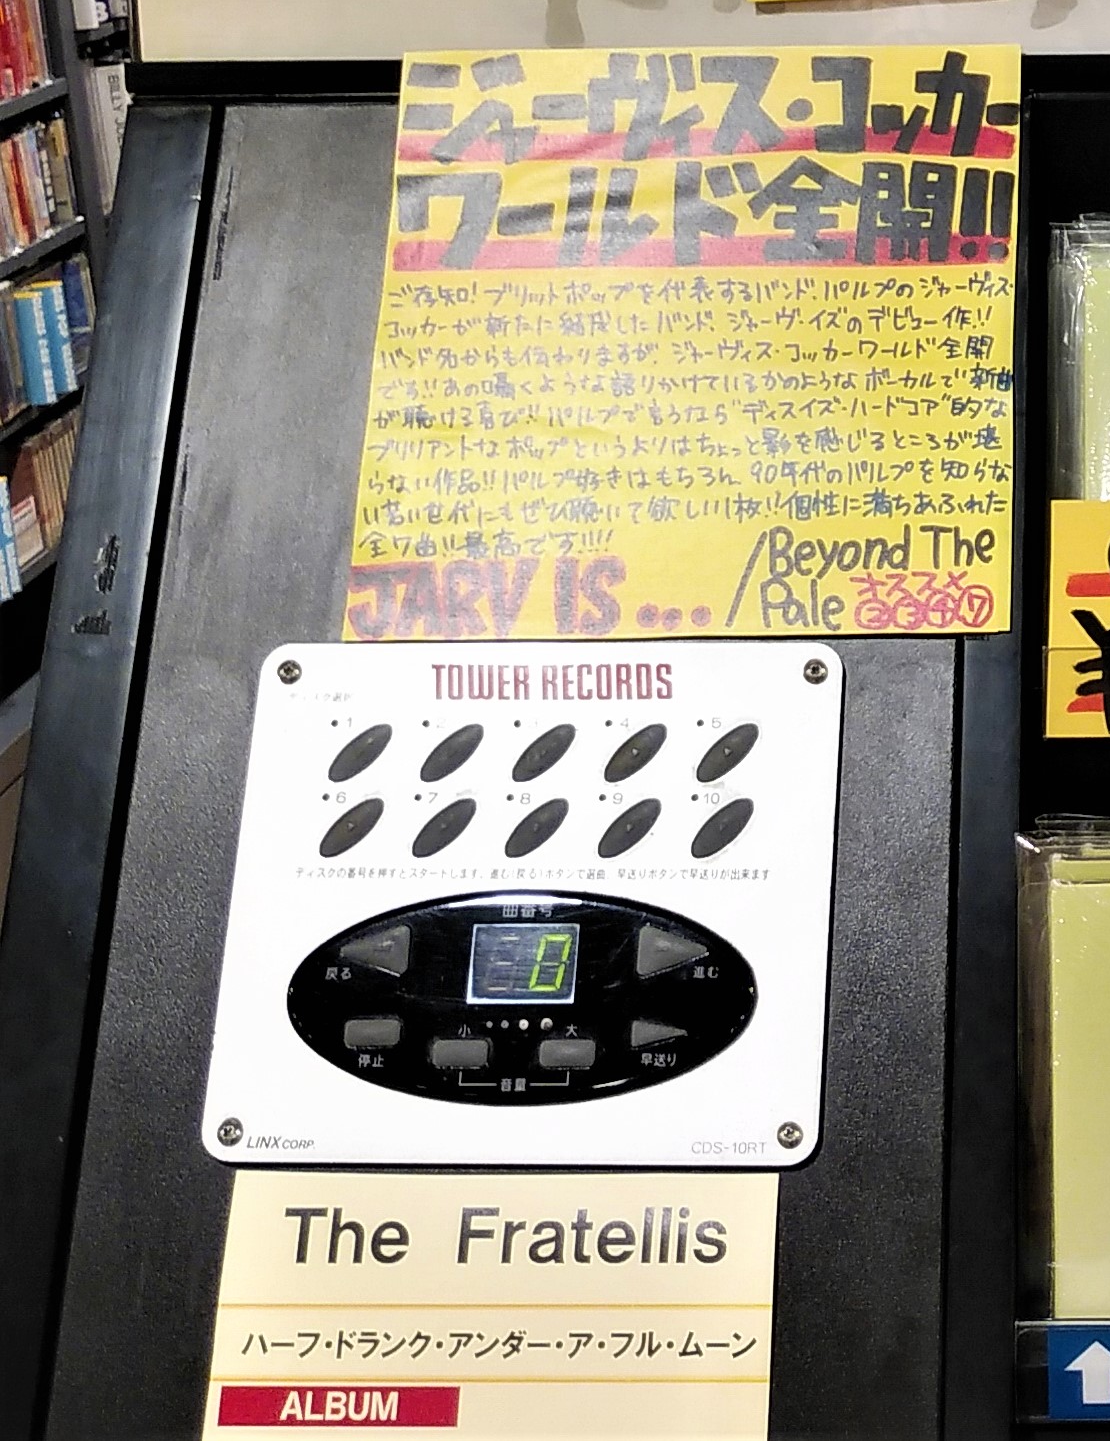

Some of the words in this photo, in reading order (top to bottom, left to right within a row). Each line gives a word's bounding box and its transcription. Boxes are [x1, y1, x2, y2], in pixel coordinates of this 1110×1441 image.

[919, 524, 996, 569] The
[348, 557, 540, 641] JARV
[760, 574, 846, 631] Pale
[431, 663, 530, 701] TOWER
[542, 663, 674, 700] RECORDS
[711, 717, 722, 729] 5
[335, 792, 347, 804] 6
[428, 792, 438, 804] 7
[520, 792, 531, 805] 8
[612, 793, 623, 805] 9
[703, 792, 721, 805] 10
[325, 967, 352, 981] 戻る
[693, 965, 720, 980] 進む
[458, 1024, 472, 1037] 小
[565, 1023, 579, 1038] 大
[358, 1053, 384, 1069] 停止
[641, 1053, 677, 1067] 早送り
[500, 1078, 527, 1092] 音量
[690, 1140, 767, 1156] CDS-10RT
[285, 1206, 410, 1264] The
[456, 1205, 728, 1265] Fratellis
[241, 1329, 758, 1360] ハーフ・ドランク・アンダー・ア・フル・ムーン
[279, 1391, 399, 1423] ALBUM
